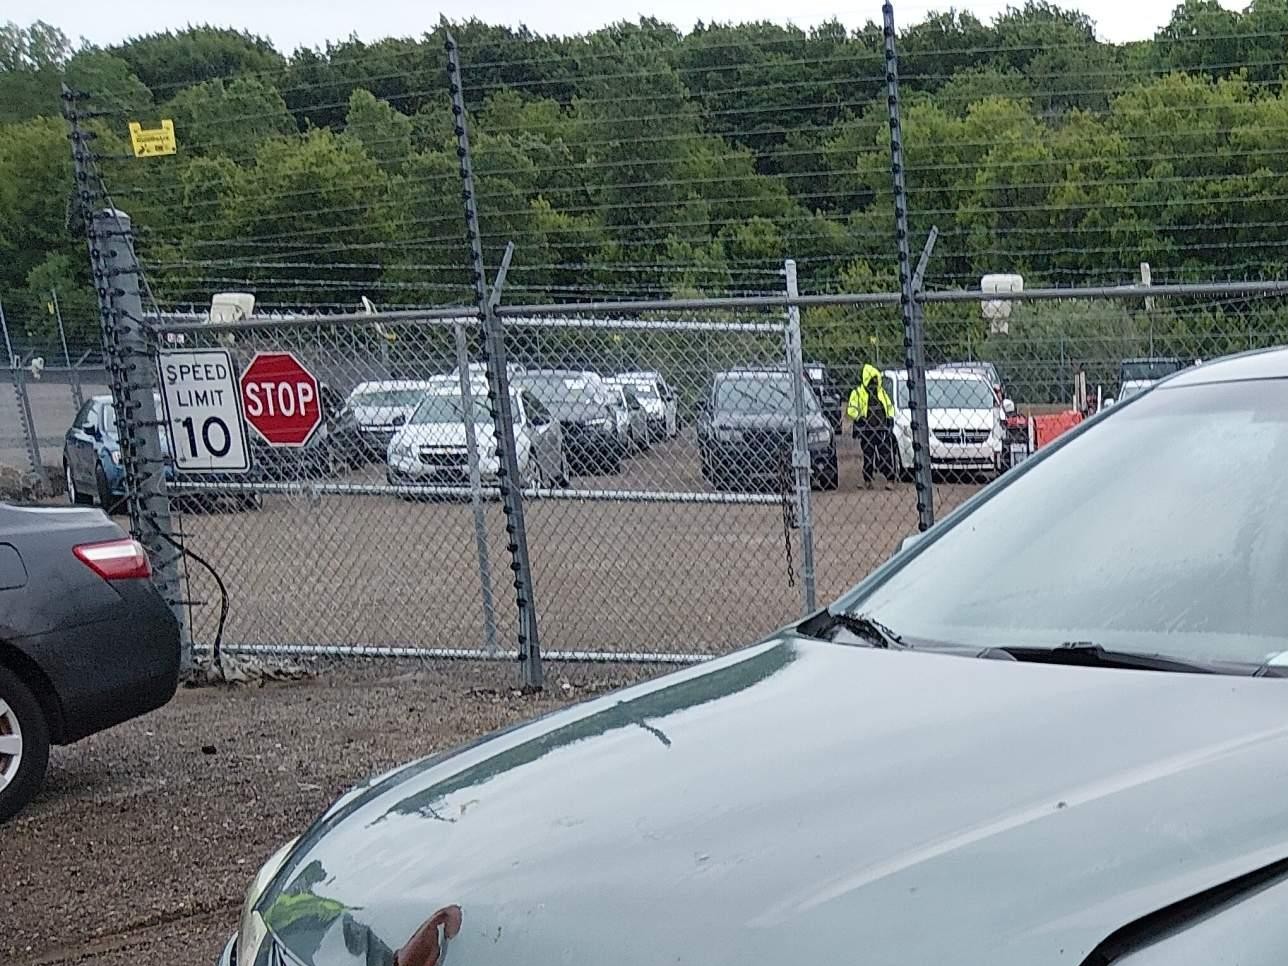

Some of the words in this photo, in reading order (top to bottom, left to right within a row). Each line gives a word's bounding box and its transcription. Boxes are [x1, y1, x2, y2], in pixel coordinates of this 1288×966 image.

[166, 364, 227, 382] SPEED
[176, 390, 224, 407] LIMIT
[245, 381, 314, 417] STOP
[182, 416, 231, 458] 10
